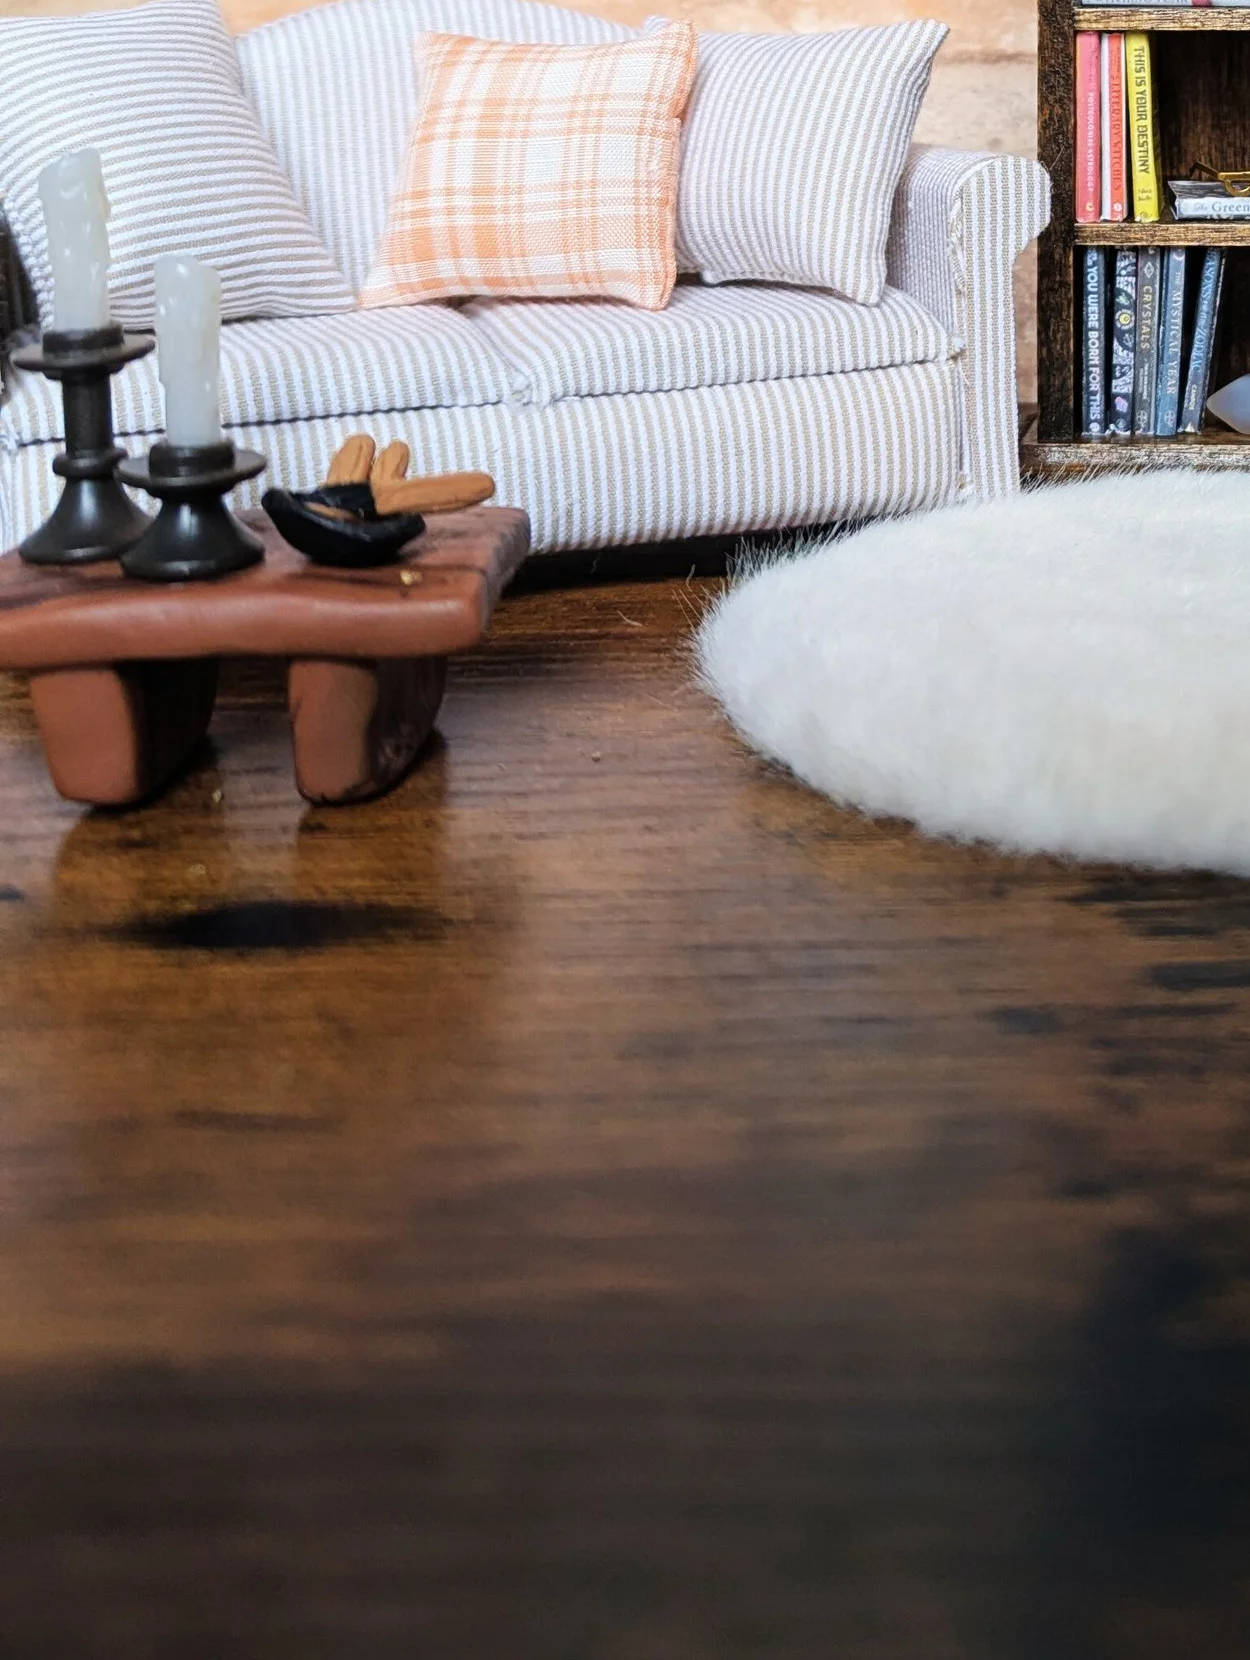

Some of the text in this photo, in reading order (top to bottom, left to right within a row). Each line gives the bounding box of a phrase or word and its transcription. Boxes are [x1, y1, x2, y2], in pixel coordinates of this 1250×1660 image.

[1111, 83, 1120, 136] LITERARY
[1134, 46, 1149, 174] THIS IS YOUR DESTINY
[1112, 140, 1121, 191] WITCHES
[1212, 203, 1250, 212] Green
[1088, 267, 1100, 420] YOU WERE BORN FOR THIS
[1141, 286, 1152, 349] CRYSTALS
[1169, 290, 1180, 355] MYSTICAL
[1192, 328, 1205, 373] ZODIAC
[1166, 361, 1178, 394] YEAR
